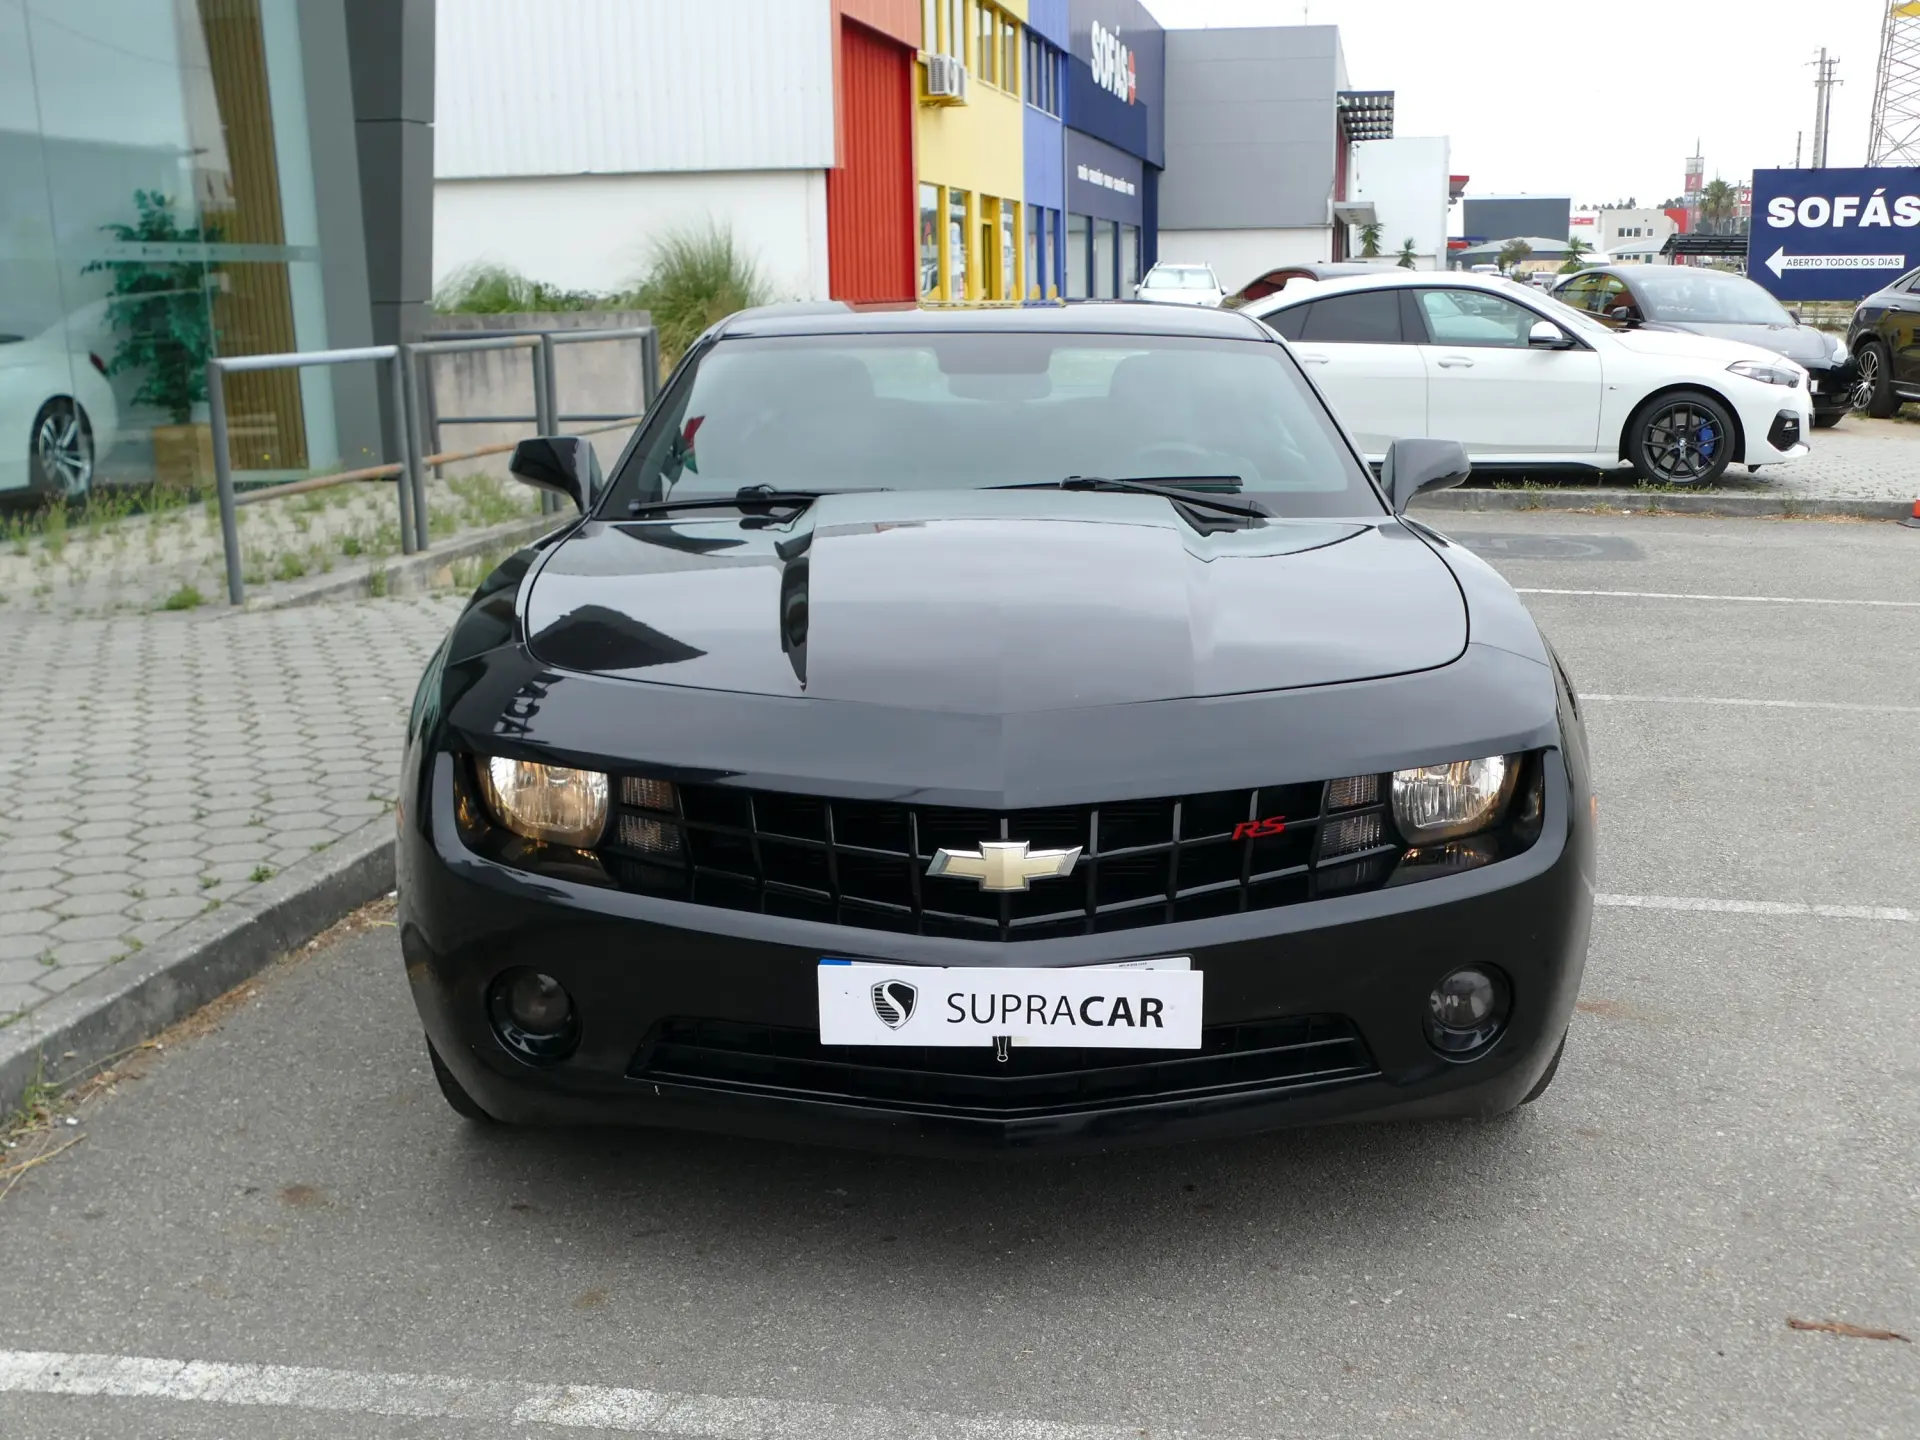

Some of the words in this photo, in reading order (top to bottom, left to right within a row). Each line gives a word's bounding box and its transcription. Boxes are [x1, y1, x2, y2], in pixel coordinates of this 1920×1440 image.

[1091, 20, 1128, 102] SOFÁS
[1767, 188, 1920, 228] SOFÁS
[1786, 258, 1823, 267] ABERTO
[1826, 258, 1859, 267] TODOS
[1861, 257, 1875, 267] OS
[1878, 257, 1900, 266] DIAS
[1232, 816, 1286, 840] RS
[946, 992, 1164, 1028] SUPRACAR
